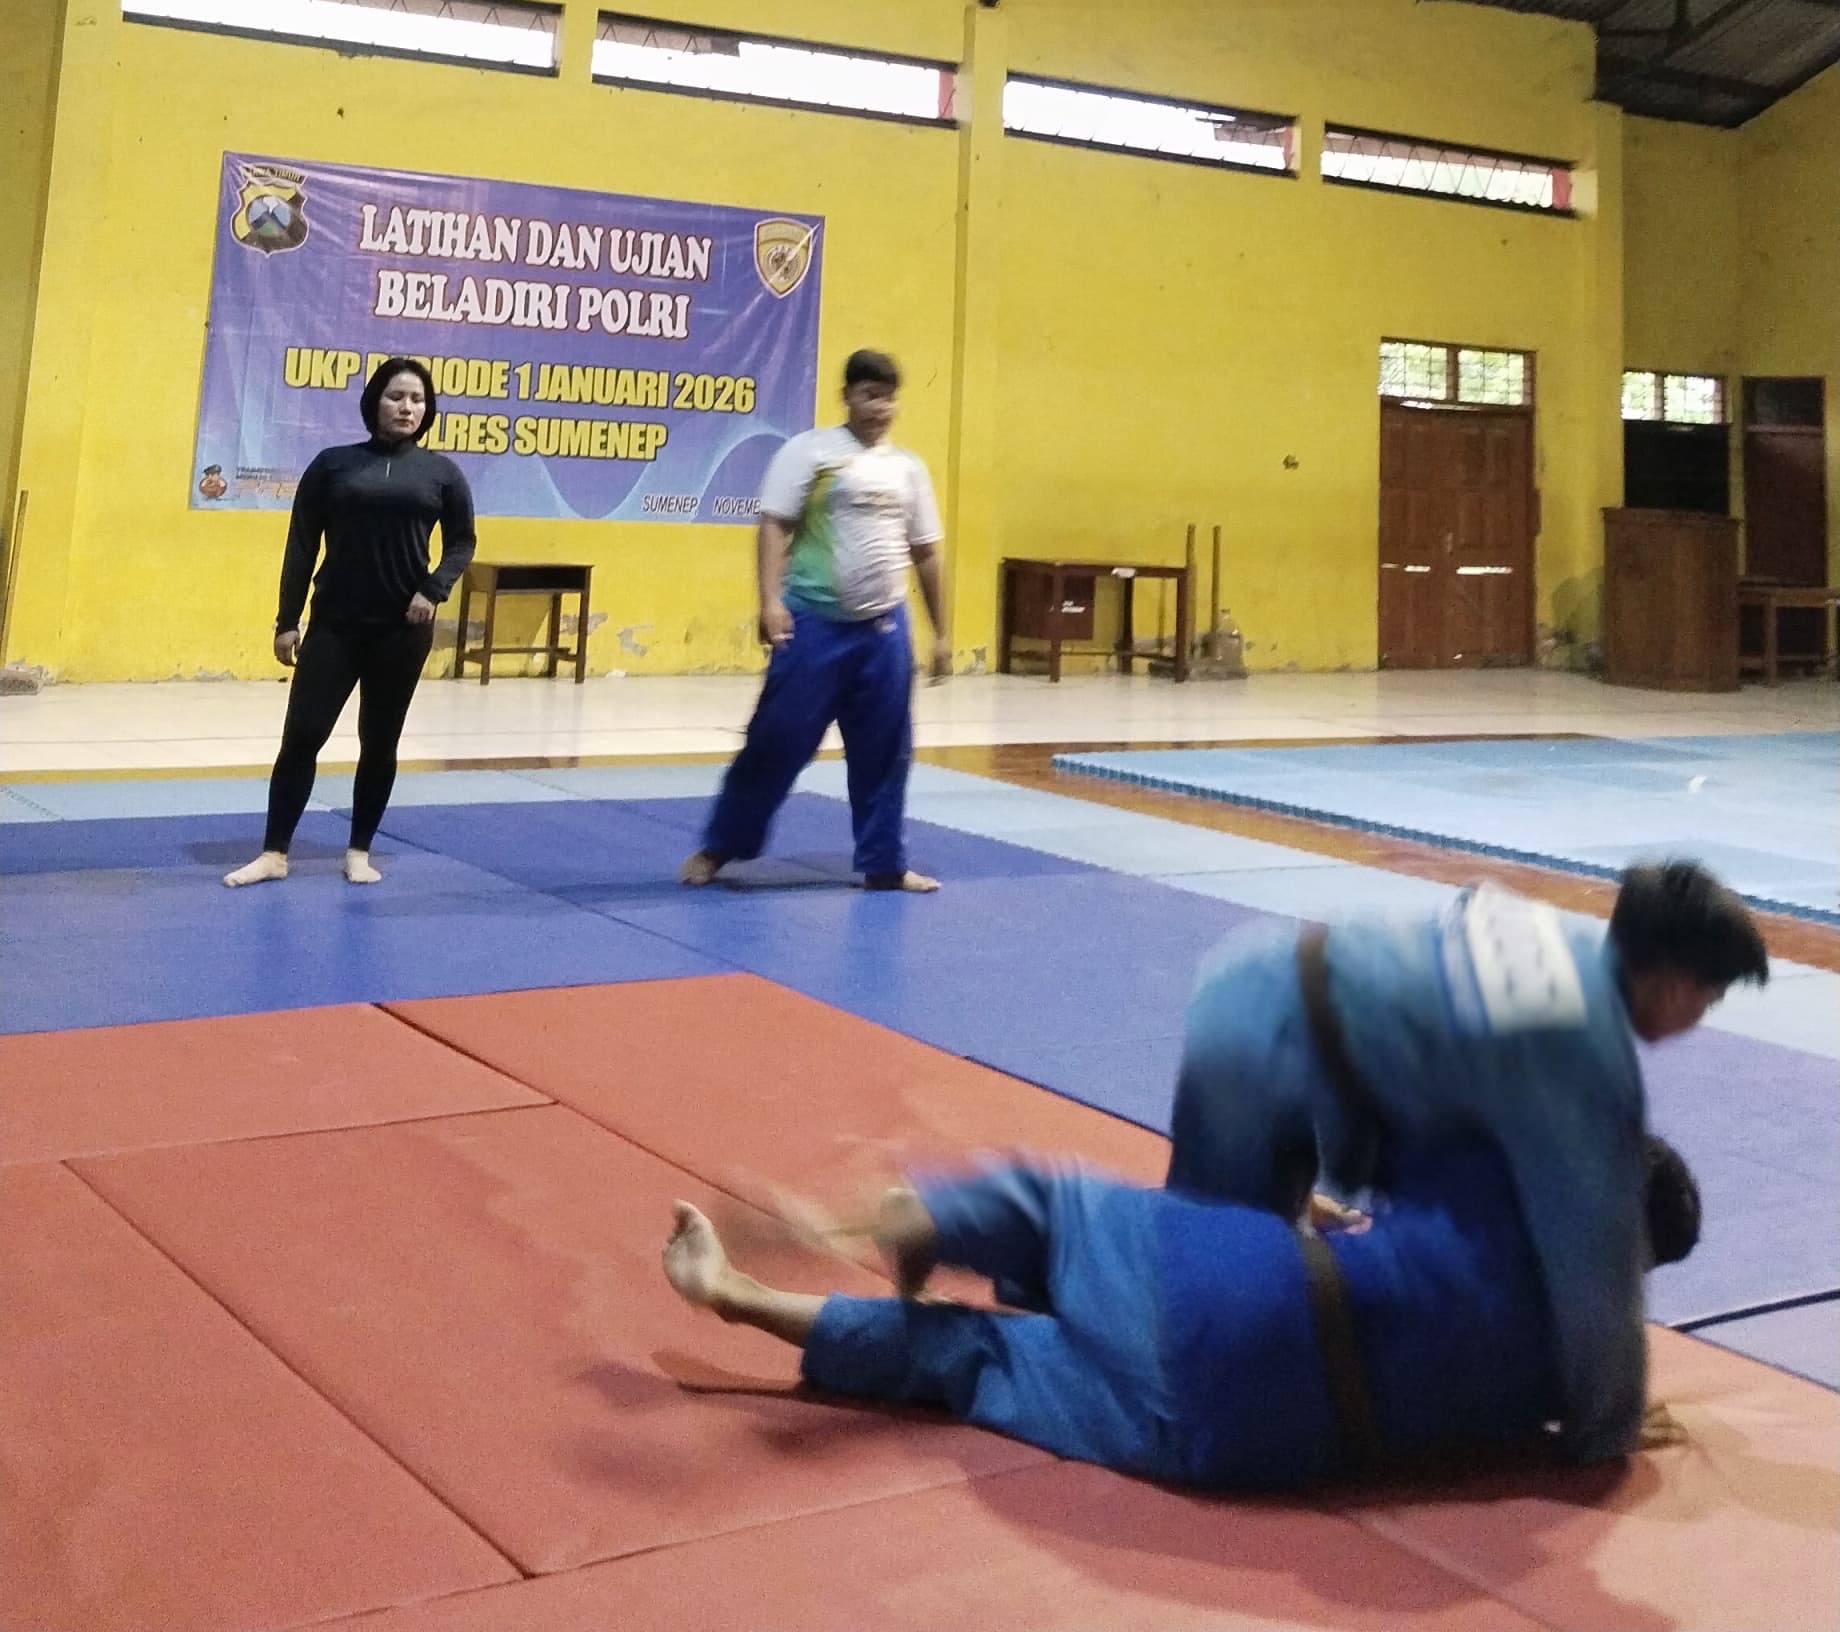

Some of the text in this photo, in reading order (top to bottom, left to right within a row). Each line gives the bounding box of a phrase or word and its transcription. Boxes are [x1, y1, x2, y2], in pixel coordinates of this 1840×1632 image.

[359, 204, 712, 281] LATIHAN DAN UJIAN
[374, 269, 690, 338] BELADIRI POLRI
[284, 346, 755, 413] UKP PIODE 1 JANUARI 2026
[416, 411, 667, 460] LRES SUMENEP
